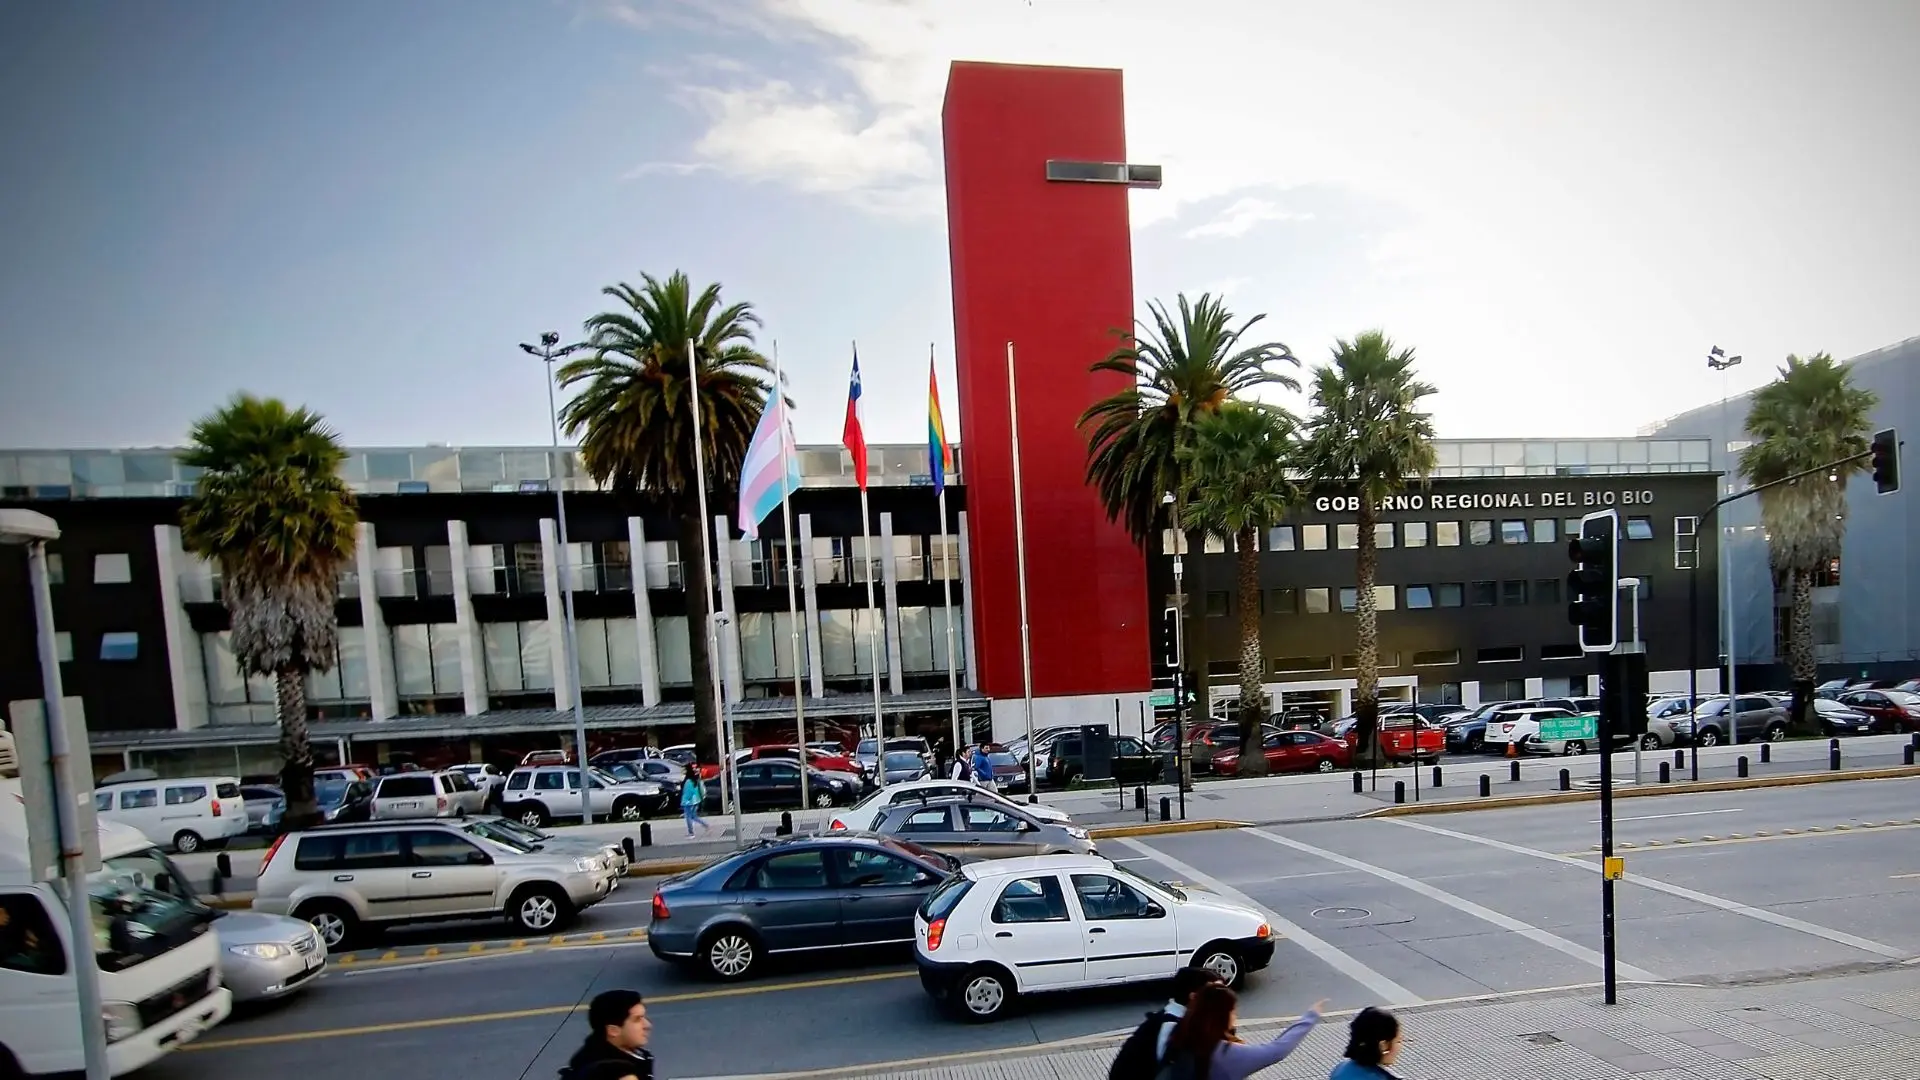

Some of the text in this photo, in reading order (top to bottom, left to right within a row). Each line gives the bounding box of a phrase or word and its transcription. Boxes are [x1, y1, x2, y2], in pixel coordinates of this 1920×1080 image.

[1315, 489, 1654, 511] GOBERNO REGIONAL DEL BIO BIO
